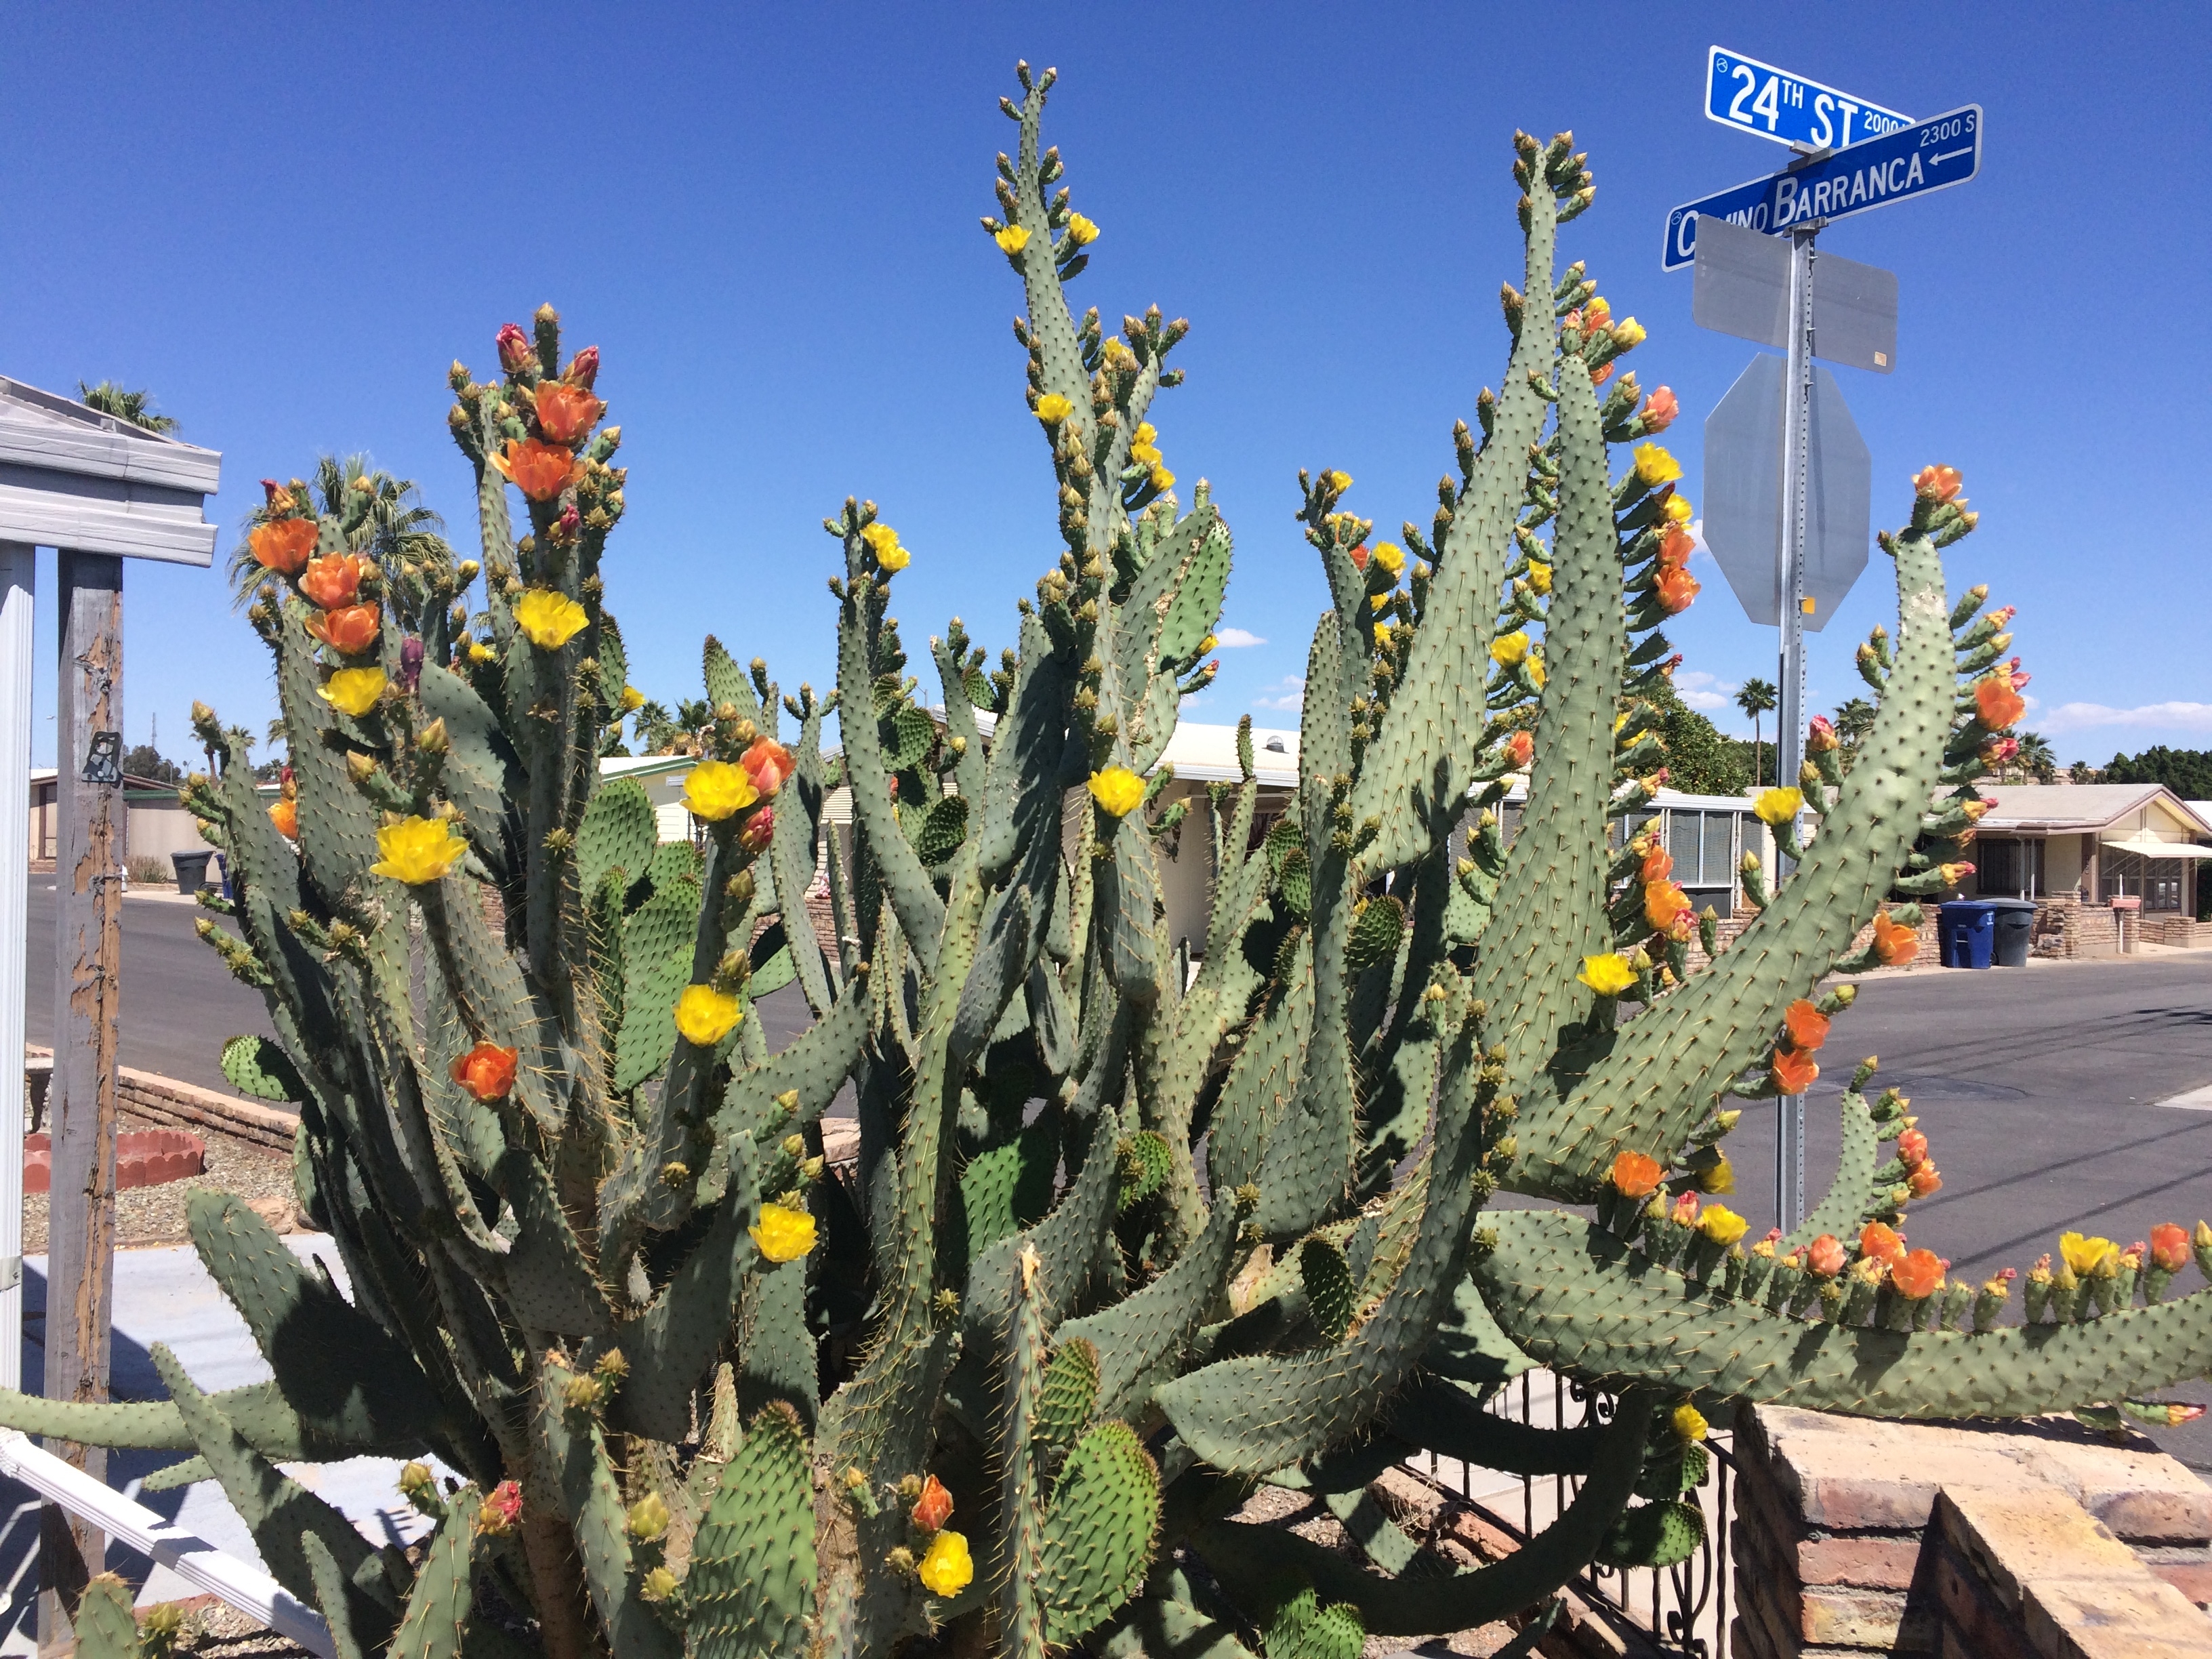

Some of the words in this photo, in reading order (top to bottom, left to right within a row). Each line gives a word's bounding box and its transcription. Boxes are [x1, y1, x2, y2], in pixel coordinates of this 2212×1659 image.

[1729, 64, 1803, 131] 24TH
[1811, 94, 1858, 148] ST
[1920, 119, 1961, 148] 2300
[1965, 114, 1975, 133] S
[1677, 202, 1768, 257] CNO
[1774, 153, 1924, 228] BARRANCA
